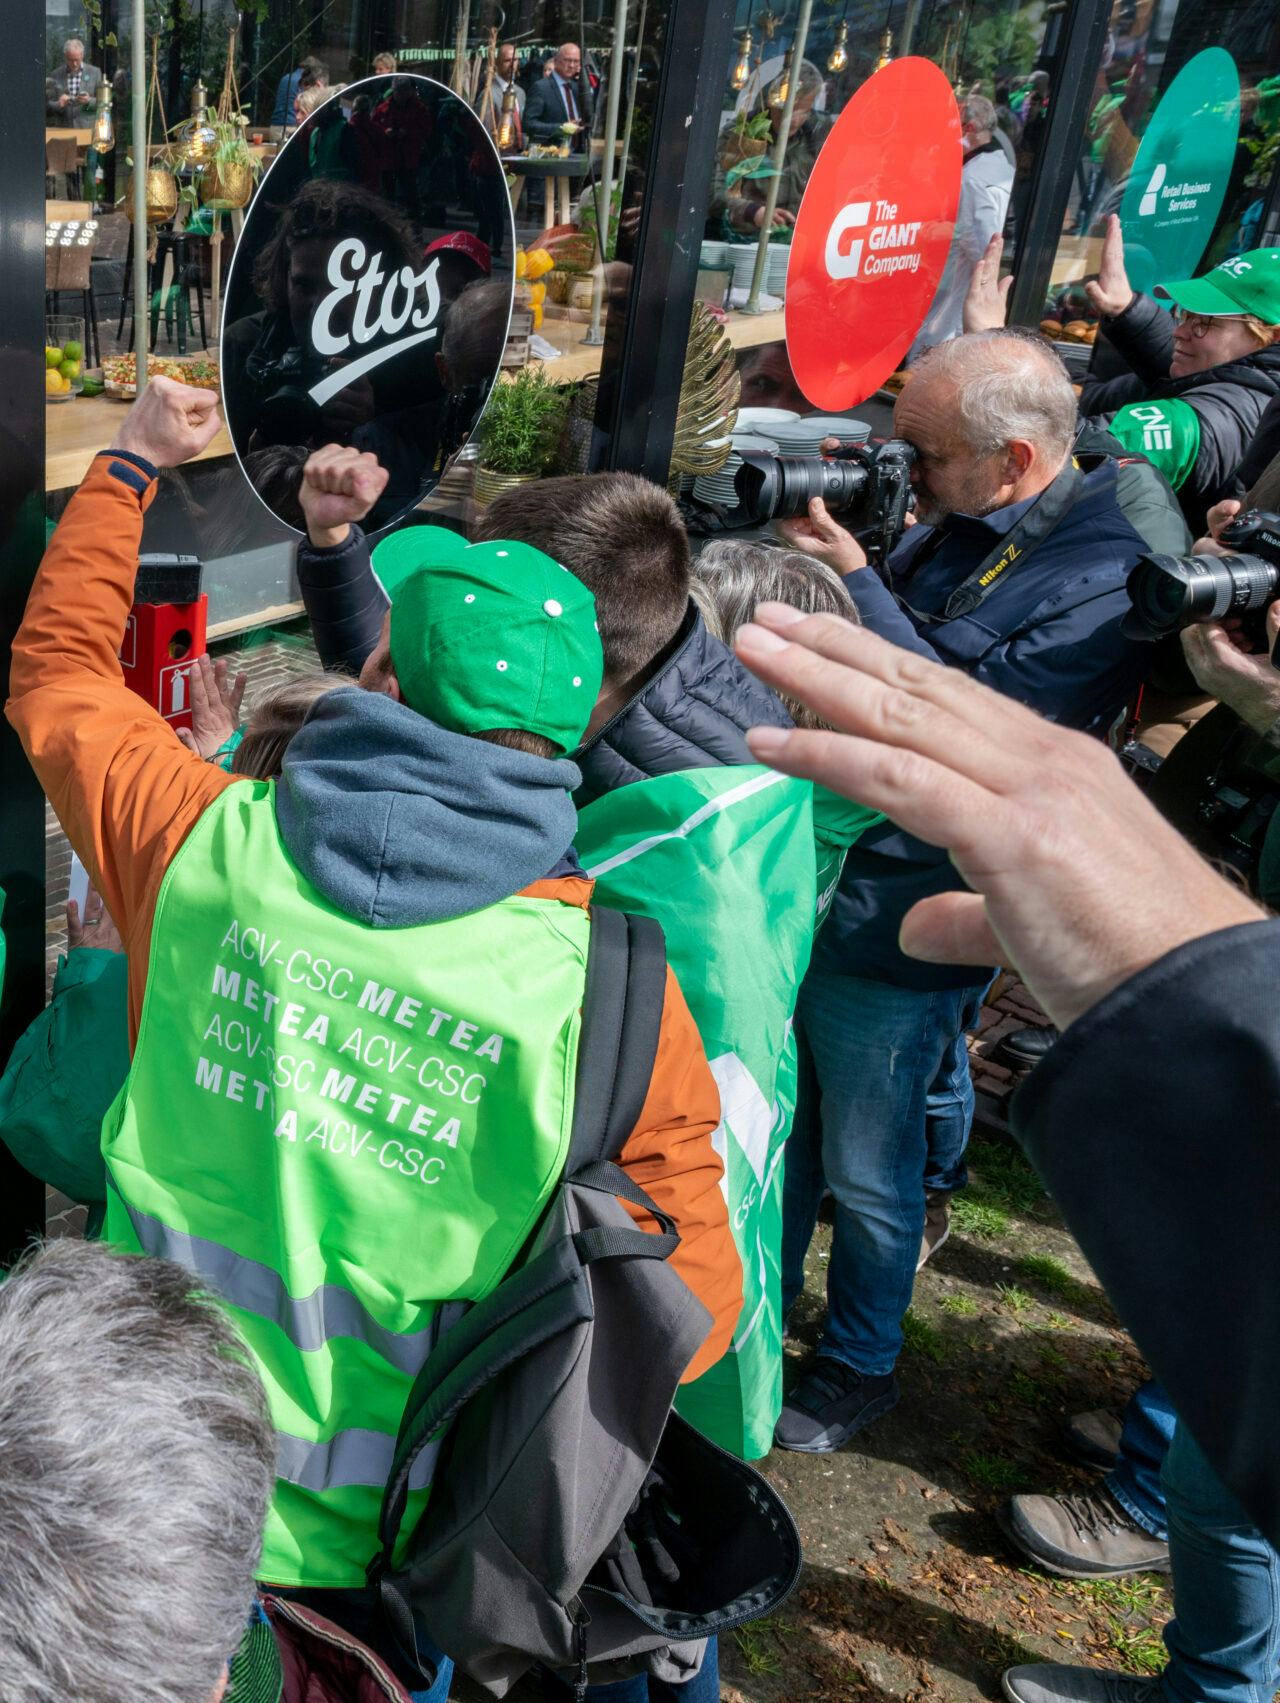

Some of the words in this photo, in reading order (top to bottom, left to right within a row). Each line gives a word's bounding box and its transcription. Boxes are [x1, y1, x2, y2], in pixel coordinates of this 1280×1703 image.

[1161, 183, 1182, 199] Retail
[1182, 182, 1211, 196] Business
[875, 200, 897, 221] The
[1168, 198, 1197, 212] Services
[869, 222, 921, 250] GIANT
[864, 254, 921, 276] Company
[311, 237, 441, 355] Etos
[979, 559, 1009, 587] Nikon
[220, 919, 354, 1000] ACV-CSC
[357, 980, 504, 1064] METEA
[211, 964, 330, 1046] METEA
[338, 1027, 487, 1104] ACV-CSC
[195, 1056, 298, 1143] META
[305, 1118, 446, 1185] ACV-CSC
[319, 1067, 462, 1149] METEA
